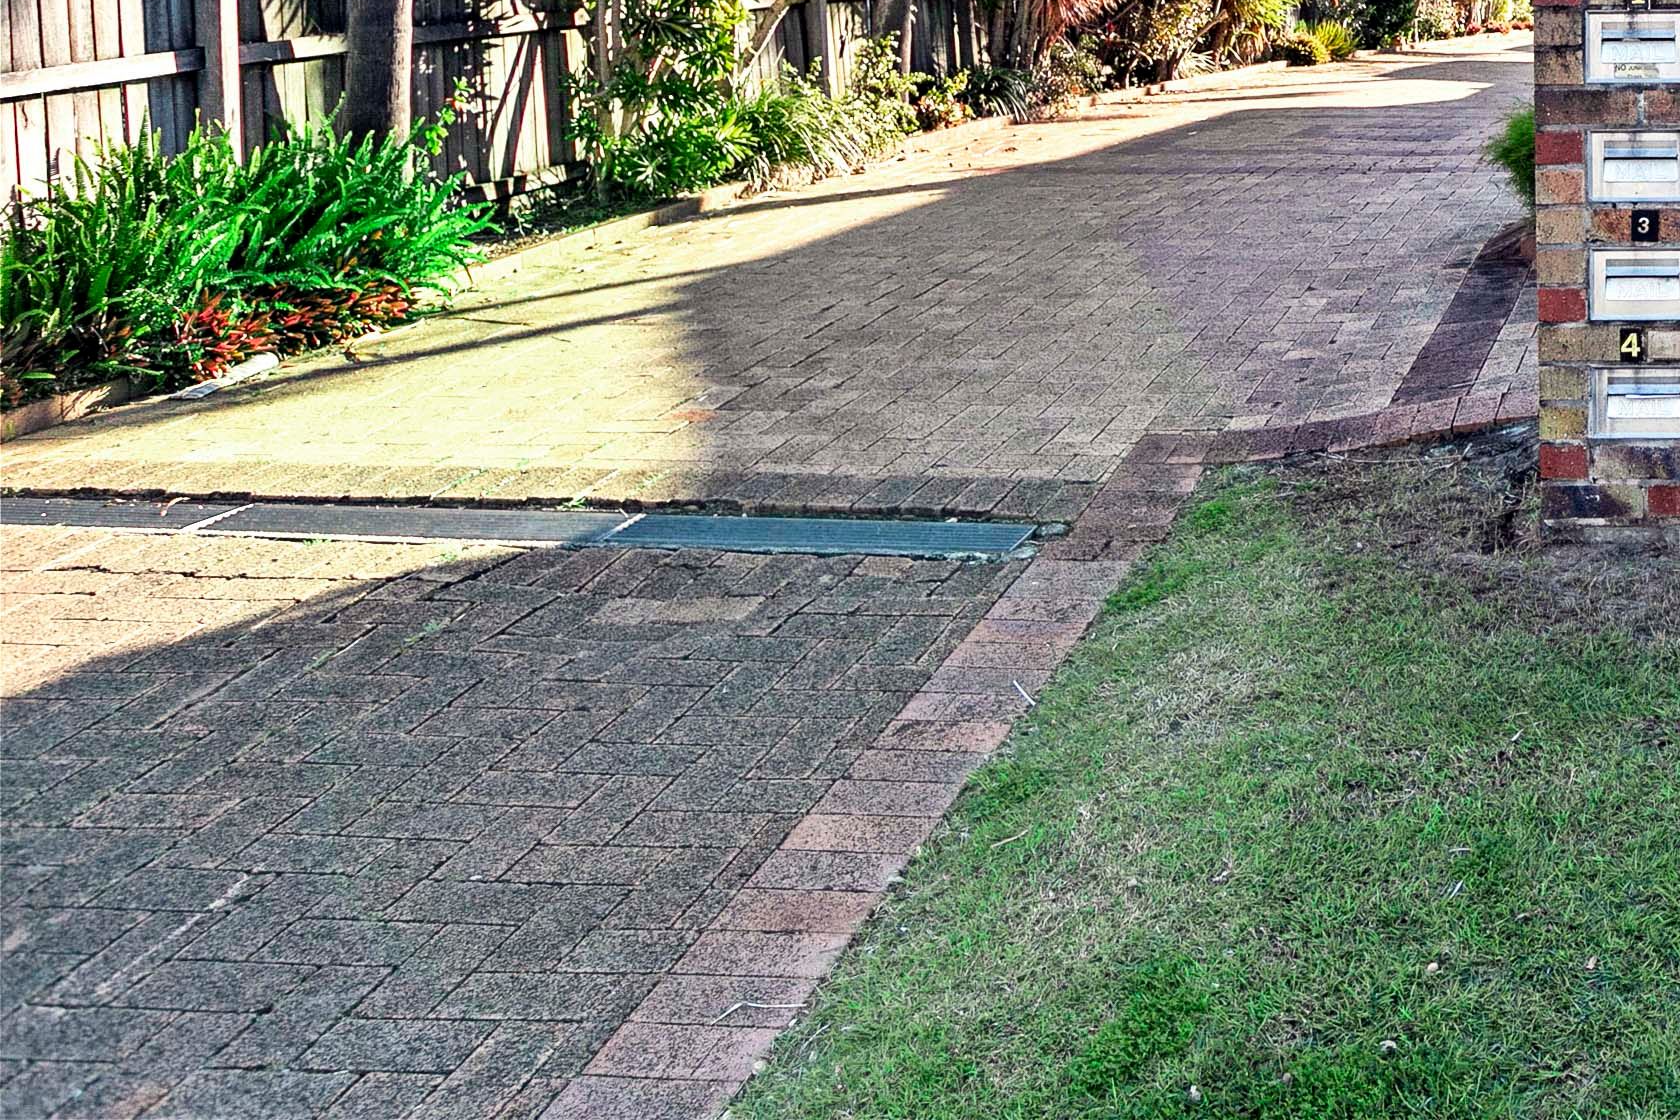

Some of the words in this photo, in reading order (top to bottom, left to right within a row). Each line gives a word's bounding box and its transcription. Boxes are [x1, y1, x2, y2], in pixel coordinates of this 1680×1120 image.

[1611, 44, 1665, 61] MAIL
[1637, 217, 1650, 234] 3
[1616, 282, 1670, 298] MAIL
[1620, 332, 1641, 358] 4
[1618, 399, 1672, 416] MAIL
